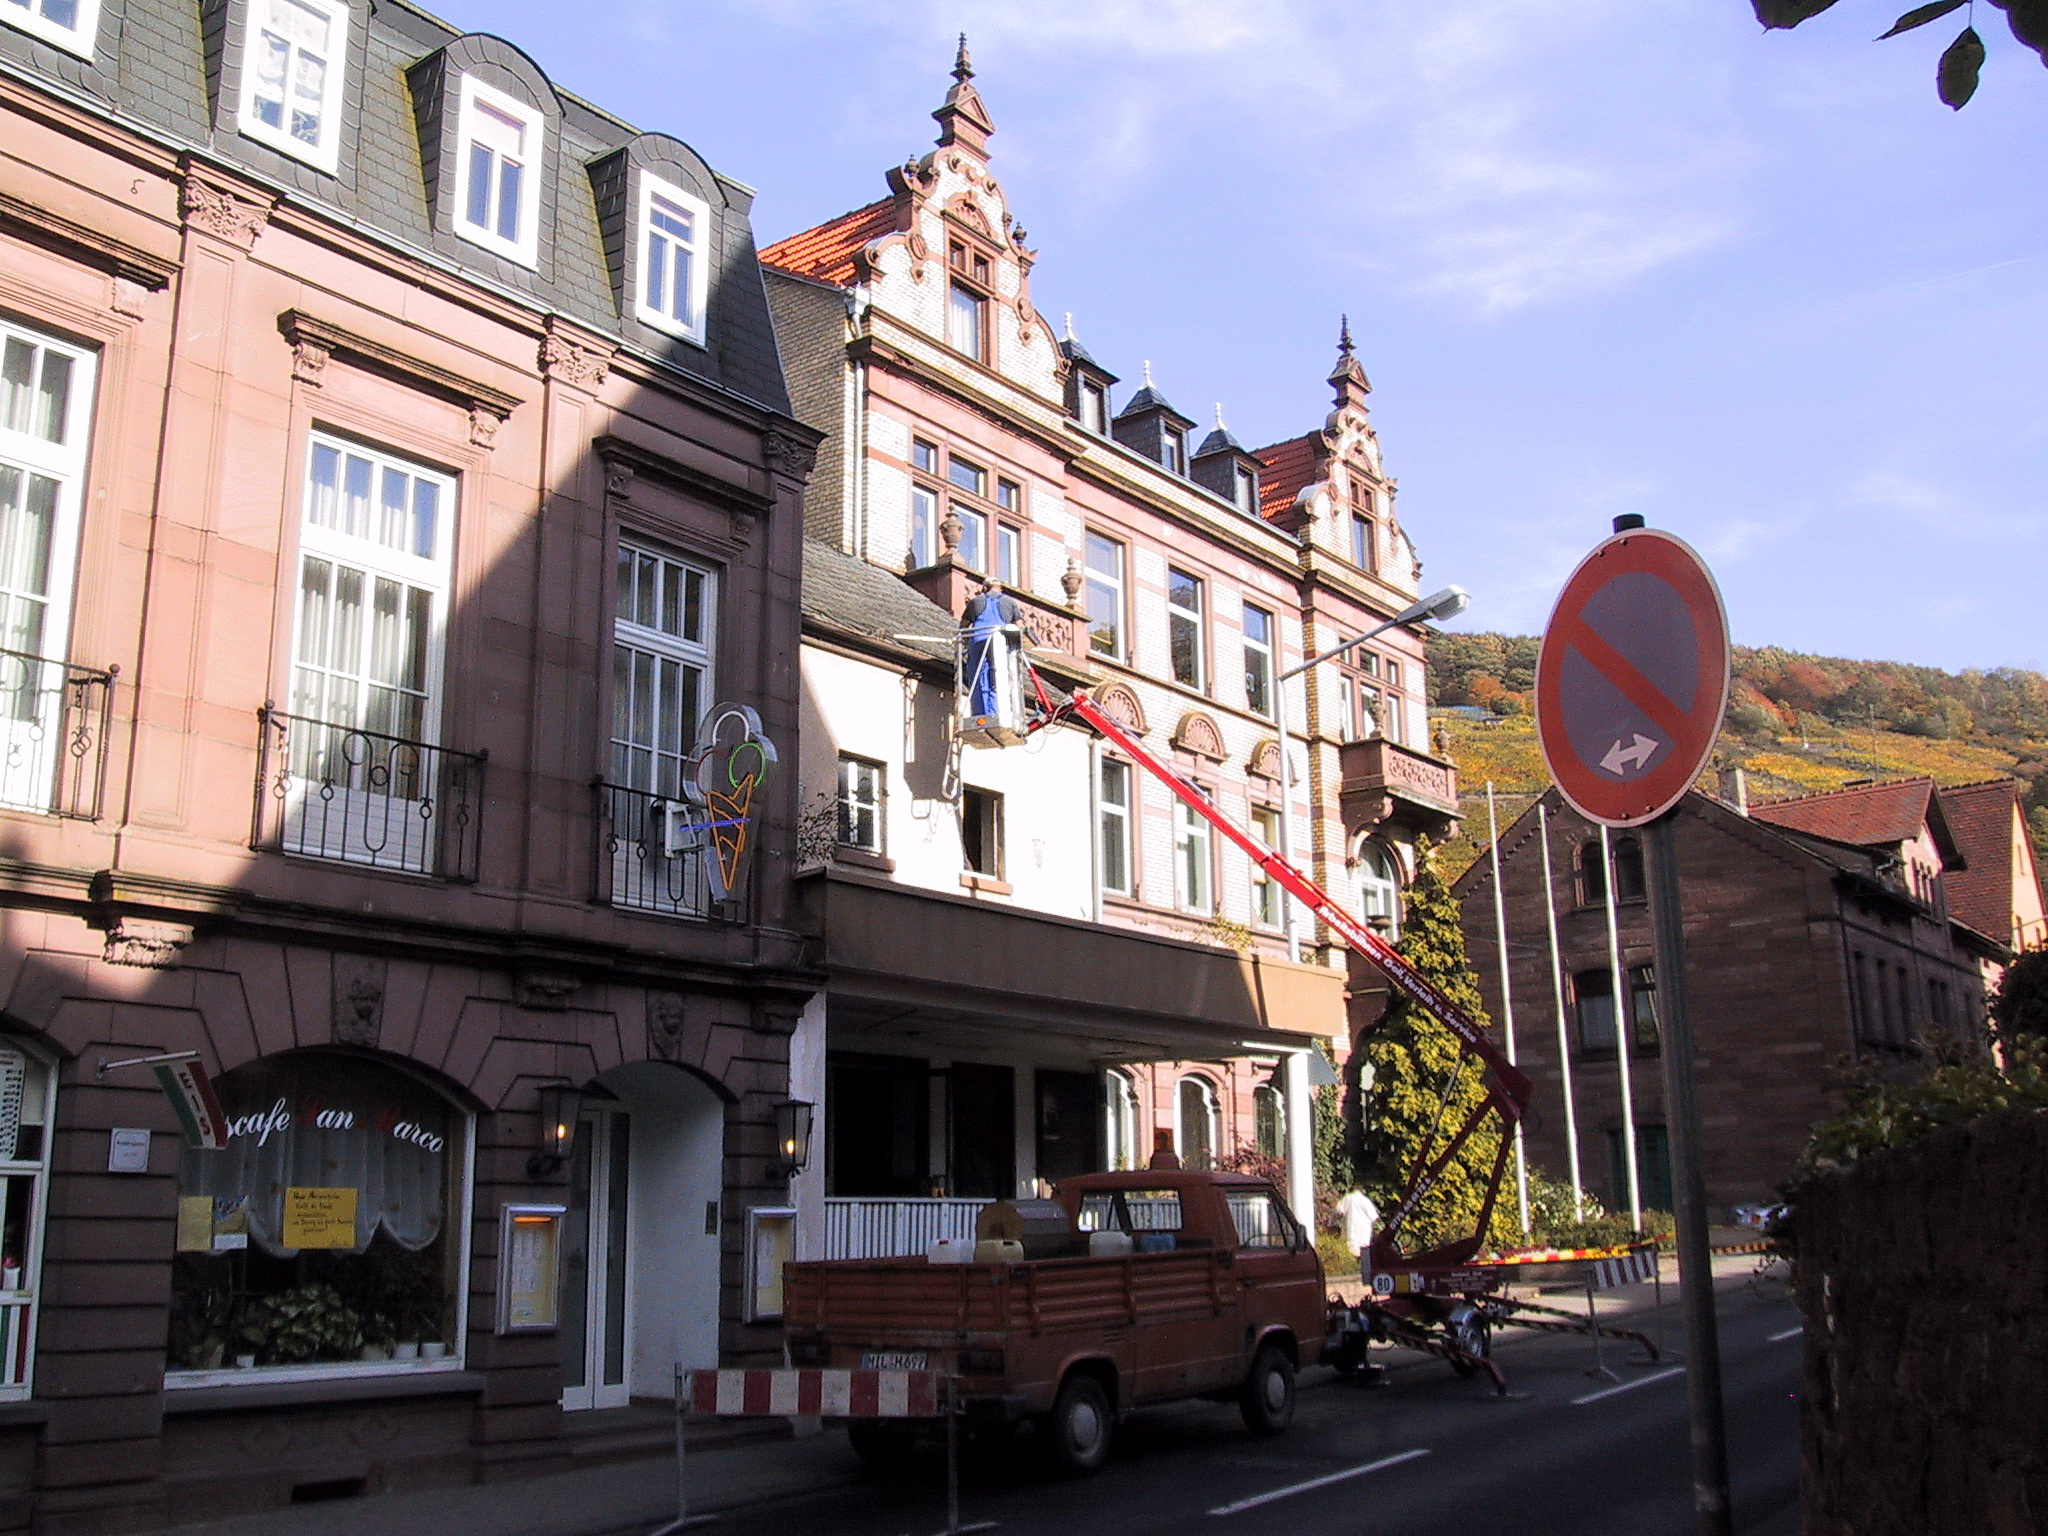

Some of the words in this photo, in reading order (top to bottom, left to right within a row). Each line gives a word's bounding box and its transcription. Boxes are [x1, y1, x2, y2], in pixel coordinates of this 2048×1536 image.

[1319, 906, 1382, 961] Arbeitsbühnen
[1403, 976, 1435, 1007] Verleih
[1444, 1012, 1478, 1044] Service
[179, 1072, 210, 1135] EIS
[1377, 1277, 1391, 1292] 80
